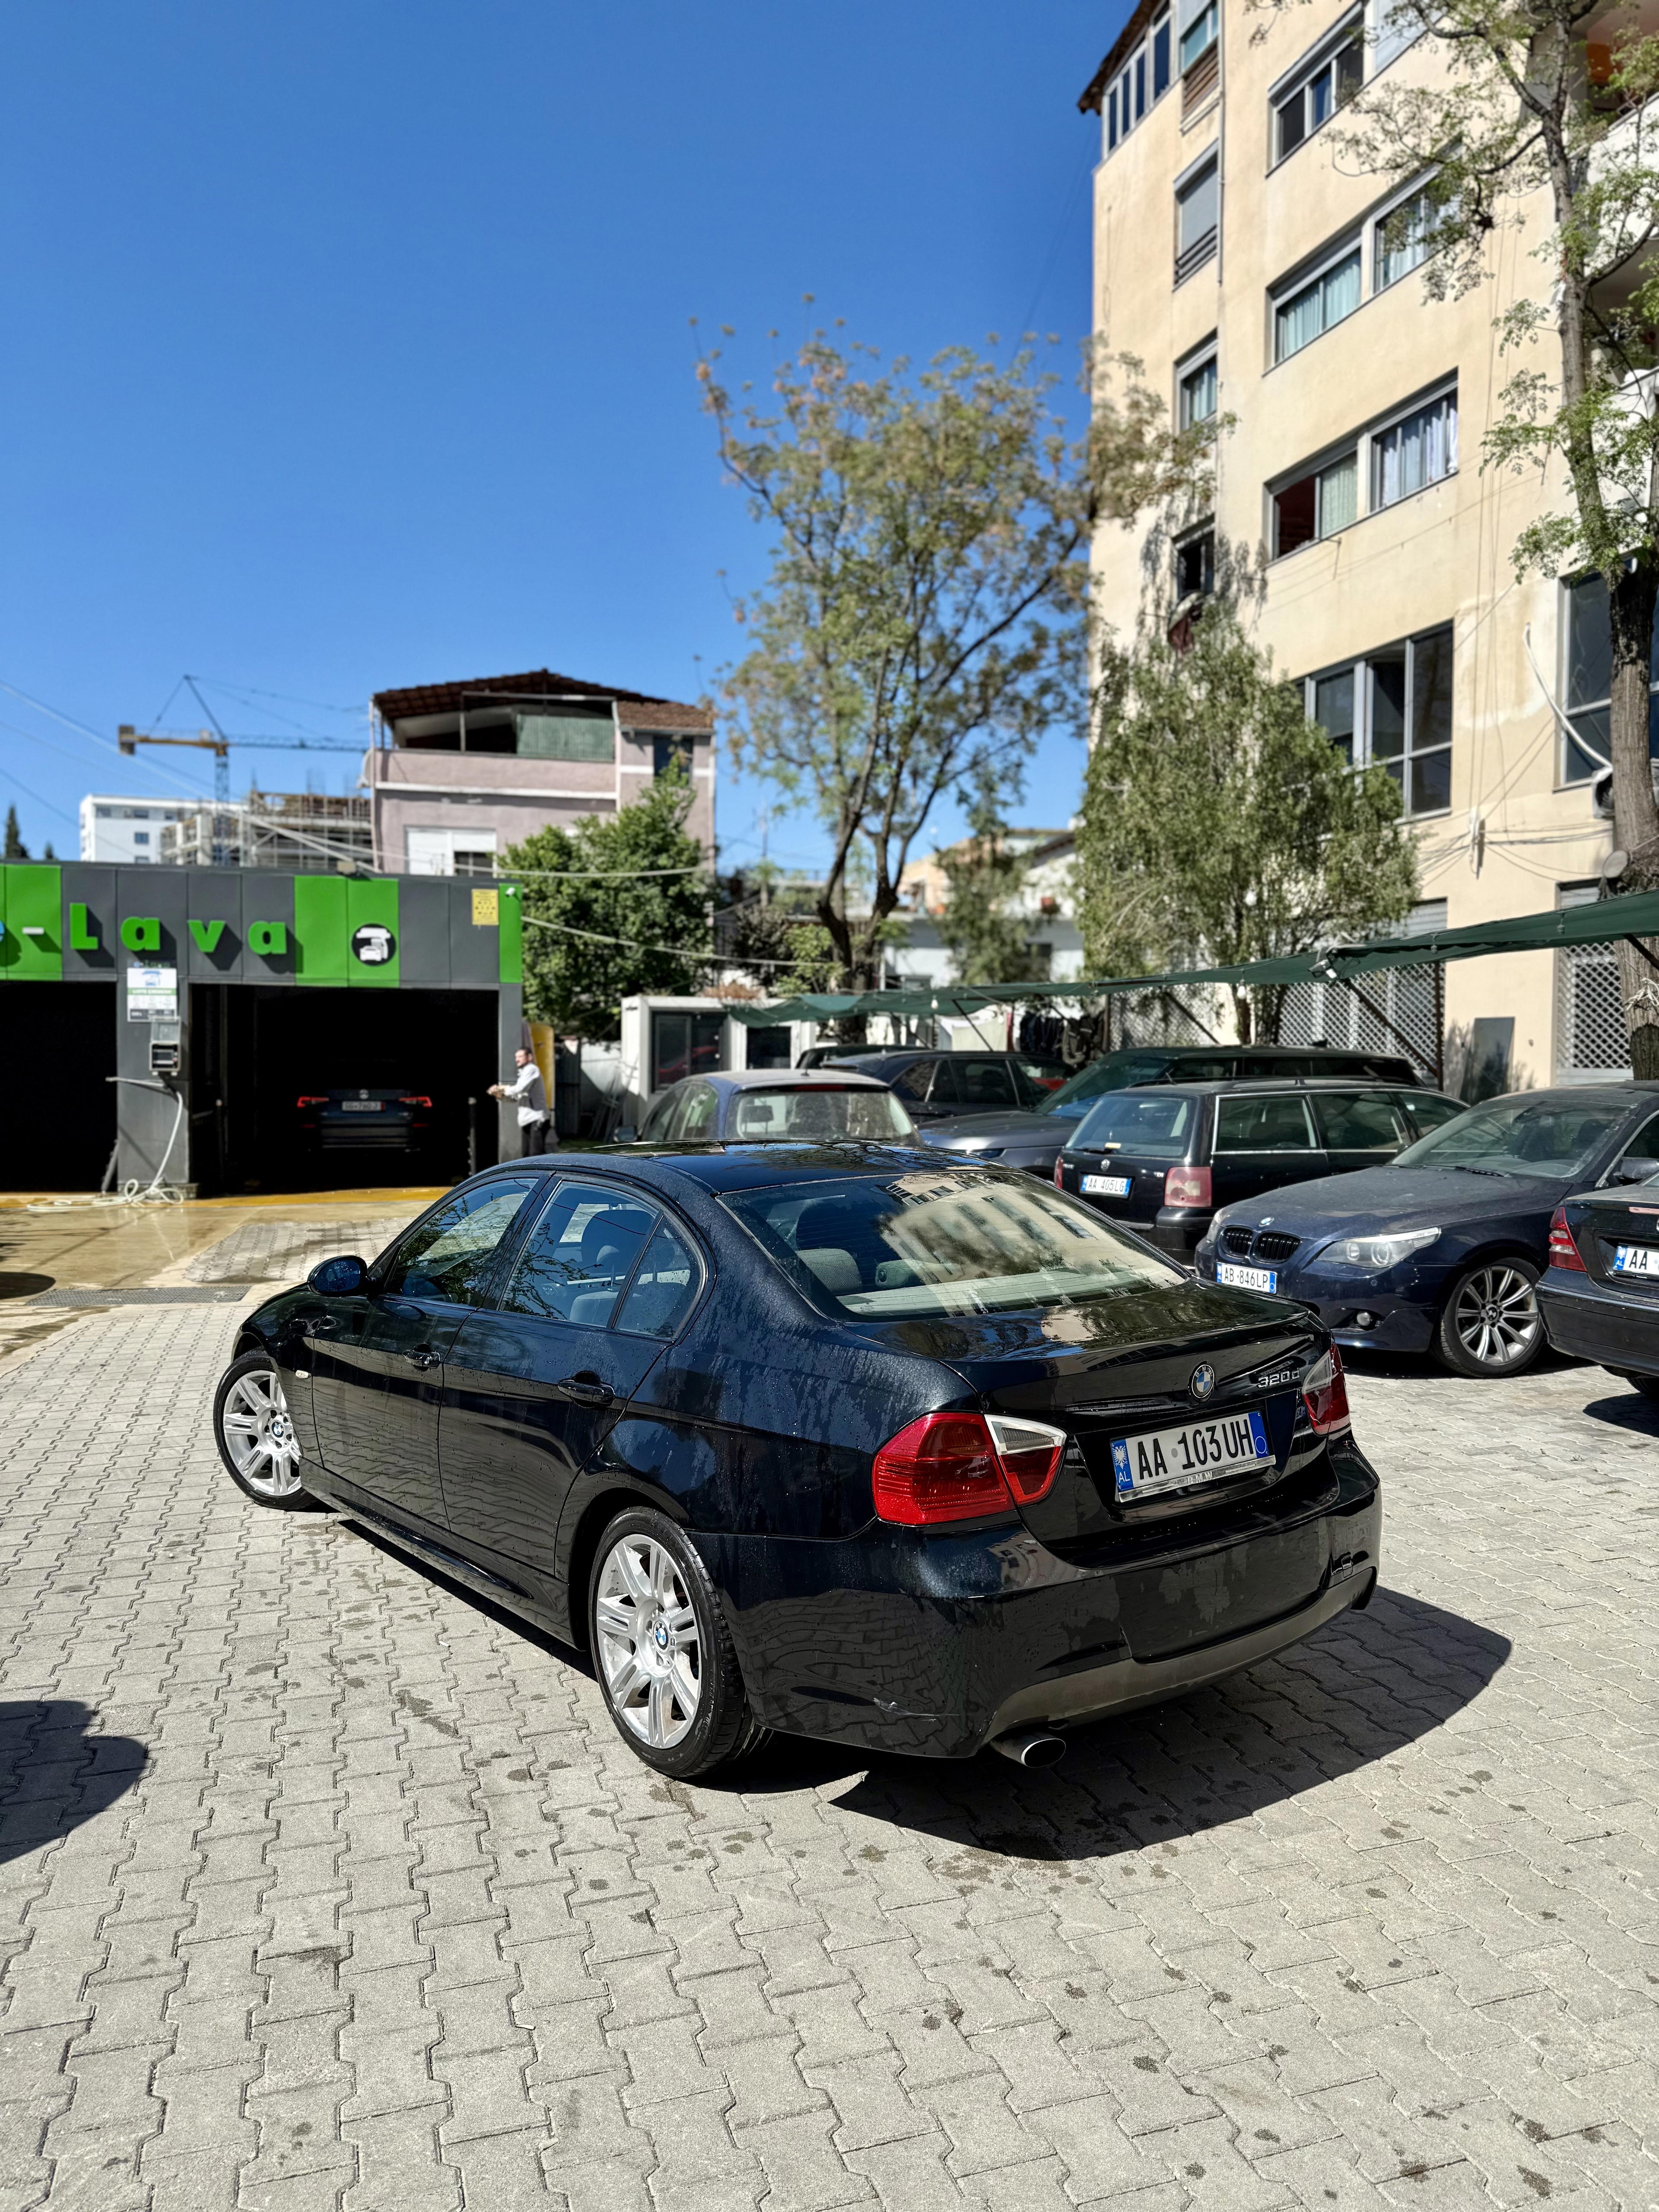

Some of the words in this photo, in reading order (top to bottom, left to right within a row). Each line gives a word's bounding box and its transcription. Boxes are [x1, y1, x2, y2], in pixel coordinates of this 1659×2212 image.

[1088, 1178, 1097, 1189] AA
[1101, 1179, 1124, 1192] 405LG
[1629, 1250, 1648, 1270] AA
[1224, 1267, 1234, 1282] AB
[1239, 1270, 1268, 1288] 846LP
[1195, 1366, 1213, 1378] BMW
[1258, 1367, 1300, 1388] 320d
[1138, 1438, 1168, 1480] AA
[1177, 1419, 1254, 1470] 103UH
[1119, 1471, 1130, 1483] AL
